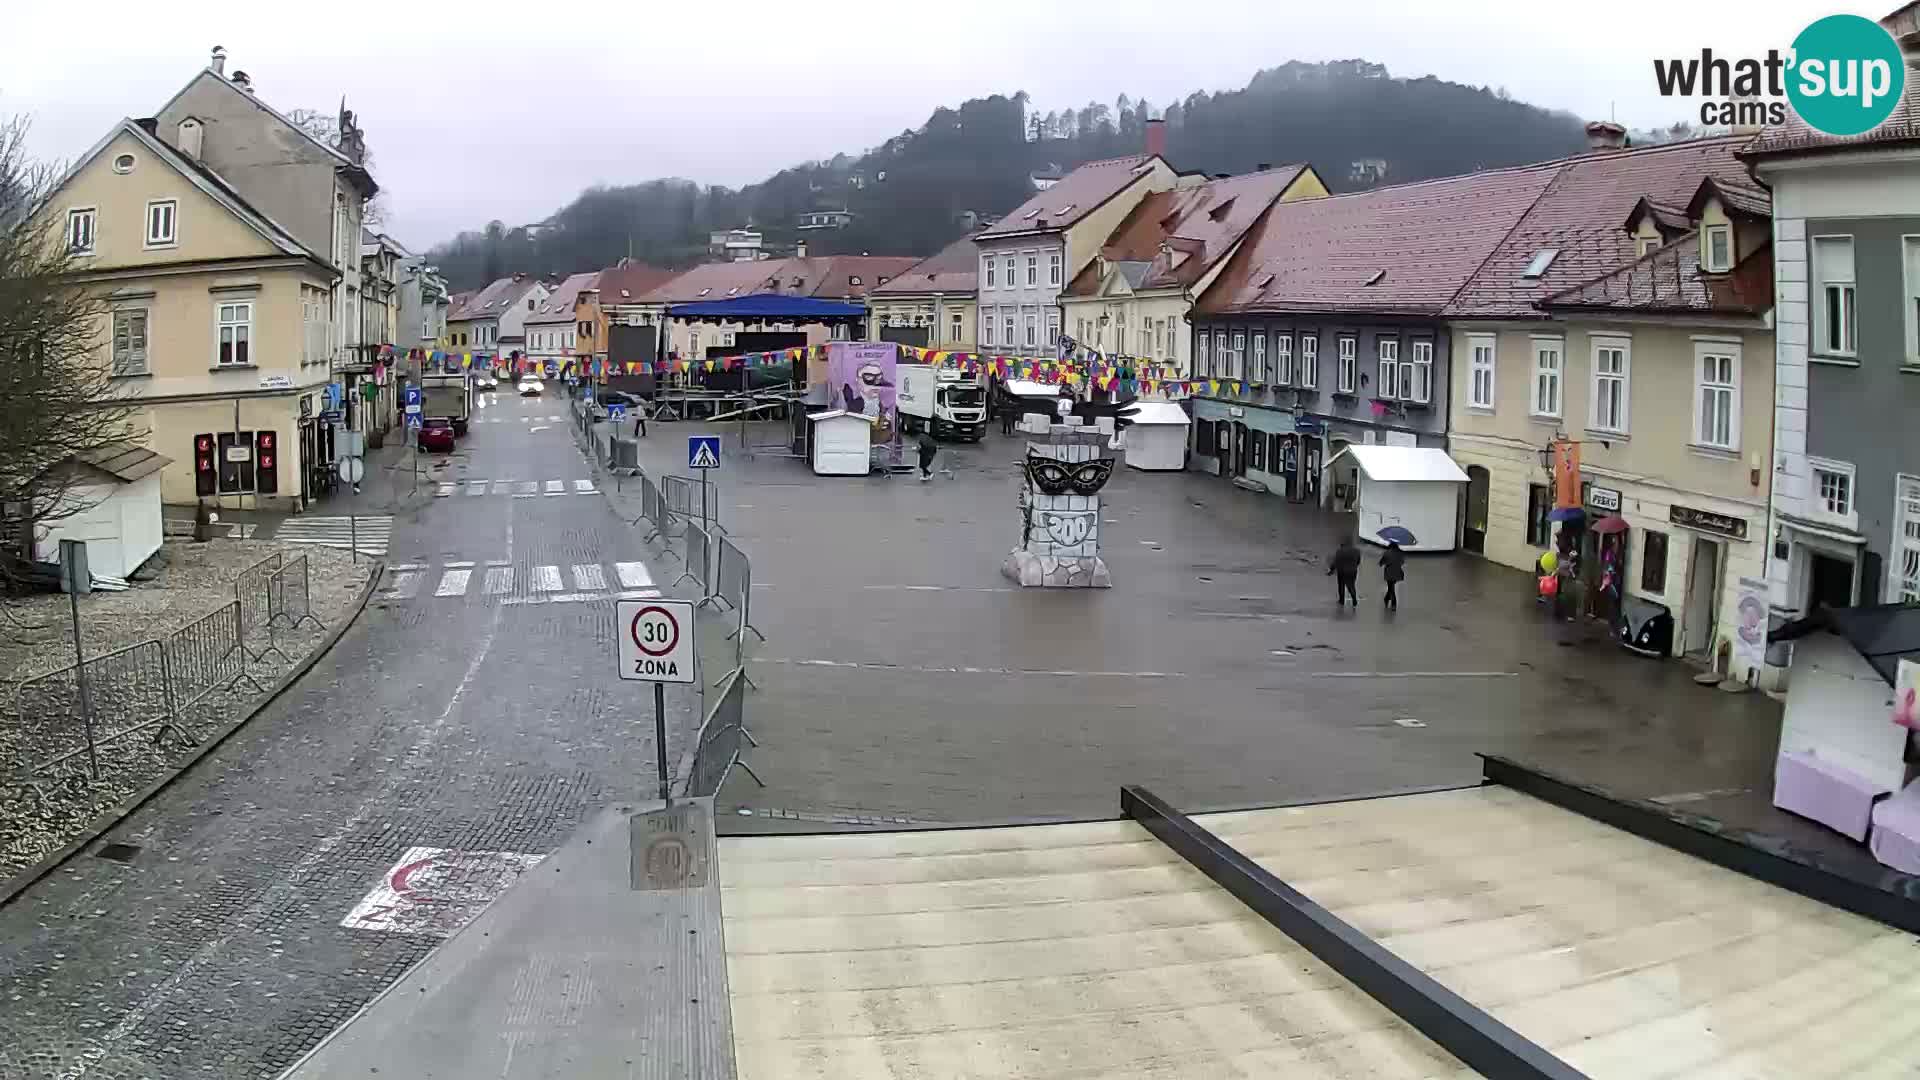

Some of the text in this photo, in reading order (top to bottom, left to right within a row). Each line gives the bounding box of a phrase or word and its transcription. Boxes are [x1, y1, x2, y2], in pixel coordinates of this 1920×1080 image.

[409, 391, 417, 402] P
[1047, 516, 1087, 544] 200
[644, 622, 667, 643] 30
[634, 659, 678, 676] ZONA
